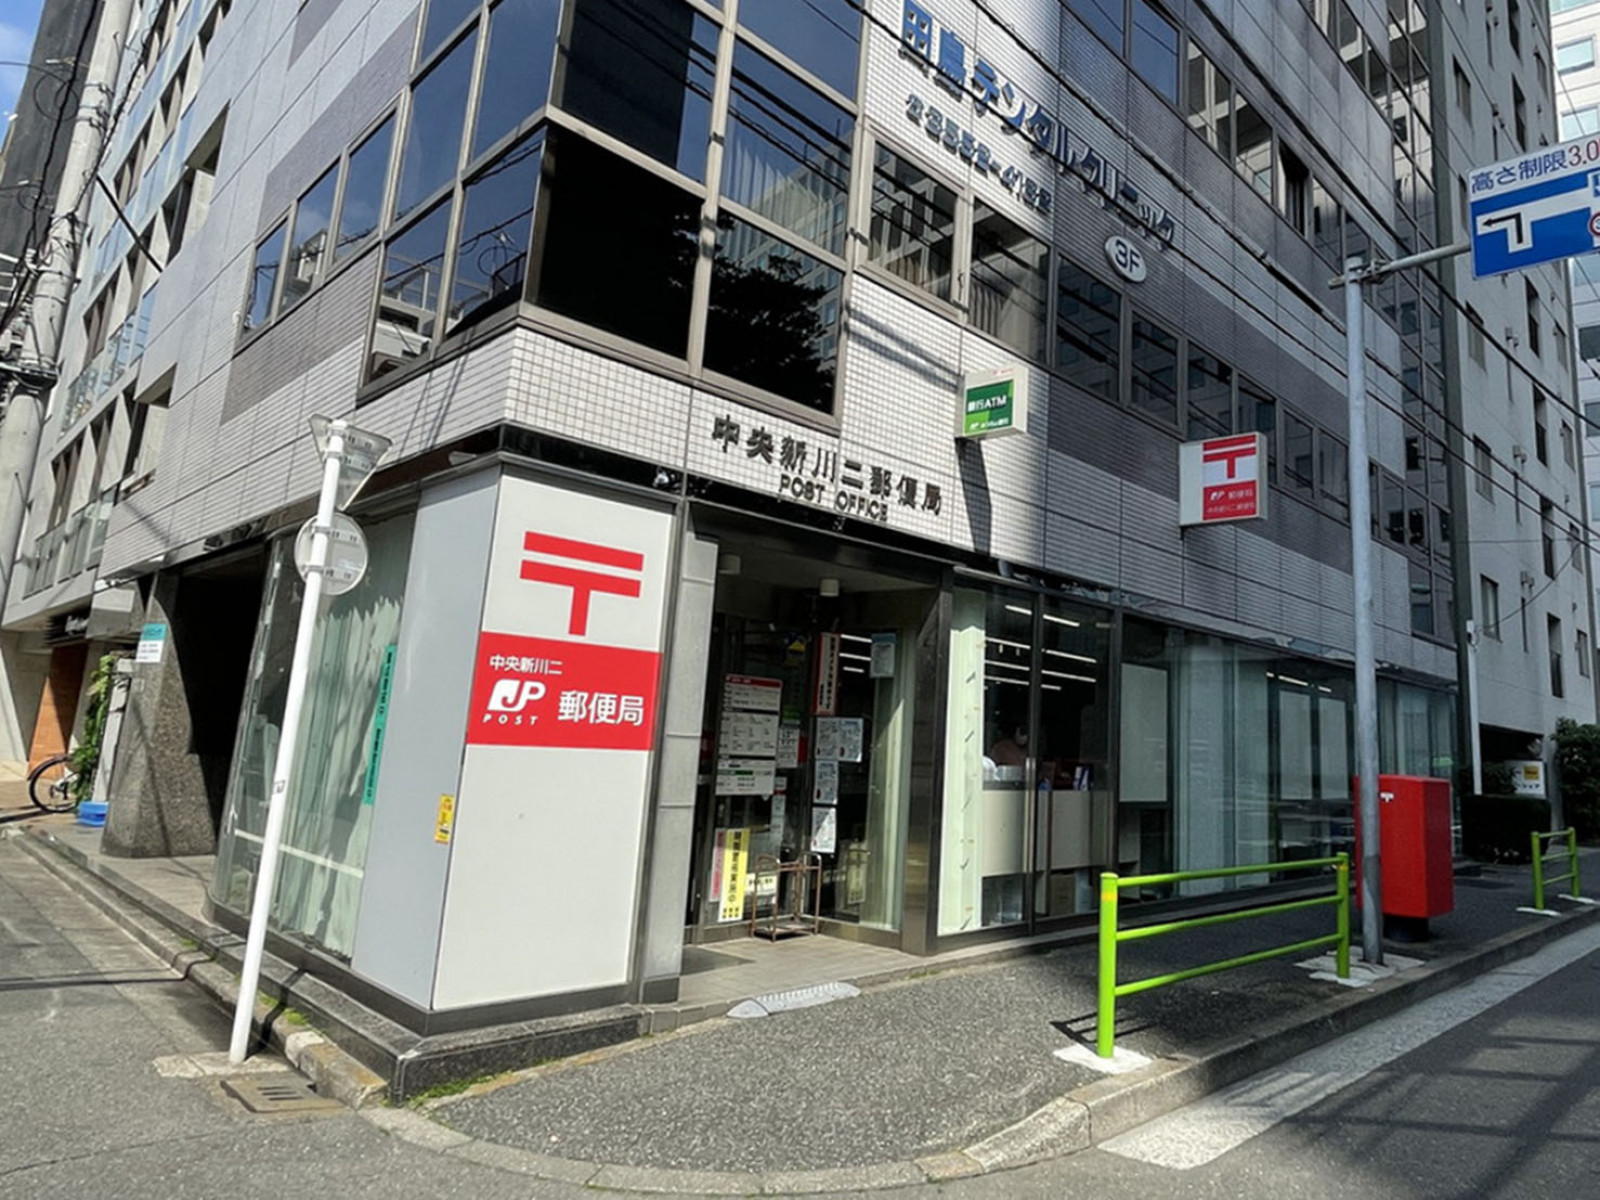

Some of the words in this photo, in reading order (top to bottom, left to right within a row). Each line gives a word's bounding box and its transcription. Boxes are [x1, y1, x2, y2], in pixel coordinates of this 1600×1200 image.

[1114, 239, 1140, 273] 3F
[711, 413, 942, 517] 中央新川二郵便局
[779, 473, 826, 504] POST
[834, 490, 889, 522] OFFICE
[489, 654, 563, 675] 中央新川二
[487, 678, 546, 712] JP
[557, 690, 645, 726] 郵便局
[482, 714, 539, 726] POST
